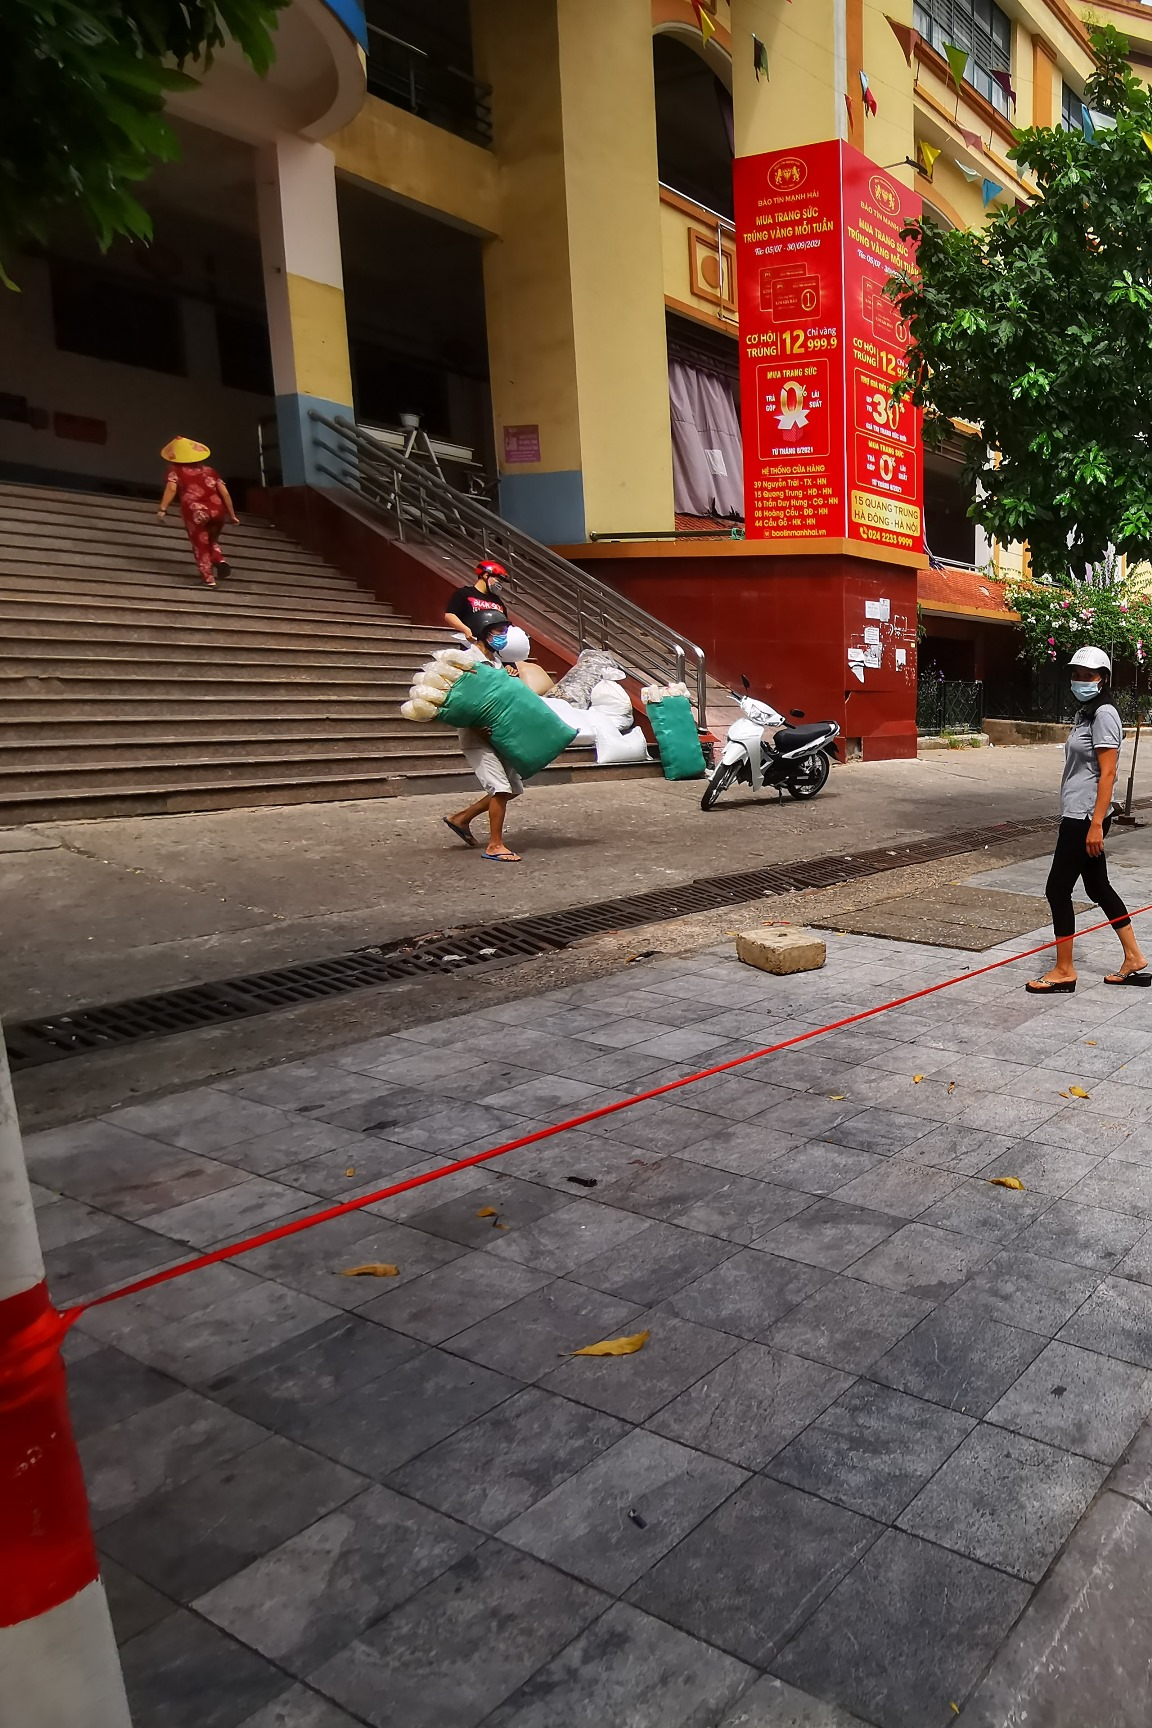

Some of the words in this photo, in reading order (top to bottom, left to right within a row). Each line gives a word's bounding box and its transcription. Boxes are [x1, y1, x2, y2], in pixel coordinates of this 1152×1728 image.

[756, 214, 772, 226] MUA
[775, 210, 800, 222] TRANG
[803, 206, 818, 218] SỨC
[744, 230, 768, 243] TRÚNG
[770, 227, 793, 239] VÀNG
[795, 221, 810, 235] MỖI
[813, 217, 834, 233] TUẦN
[859, 218, 874, 236] MUA
[875, 228, 895, 249] TRANG
[848, 226, 869, 248] TRÚNG
[871, 238, 889, 259] VÀNG
[746, 334, 758, 344] CƠ
[761, 331, 776, 344] HỘI
[782, 330, 805, 354] 12
[807, 327, 818, 336] Chỉ
[820, 327, 836, 336] vàng
[747, 346, 776, 358] TRÚNG
[807, 337, 837, 351] 999.9
[853, 338, 863, 348] CƠ
[864, 341, 876, 354] HỘI
[880, 351, 896, 376] 12
[853, 349, 876, 367] TRÚNG
[783, 369, 802, 377] TRANG
[771, 465, 791, 474] THỐNG
[807, 464, 825, 472] HÀNG
[854, 495, 864, 506] 15
[865, 498, 892, 513] QUANG
[894, 505, 918, 519] TRUNG
[854, 509, 866, 520] HÀ
[868, 512, 890, 526] ĐÔNG
[894, 519, 904, 530] HÀ
[907, 521, 918, 534] NỘI
[868, 530, 880, 540] 024
[882, 532, 897, 544] 2233
[898, 536, 912, 547] 9999
